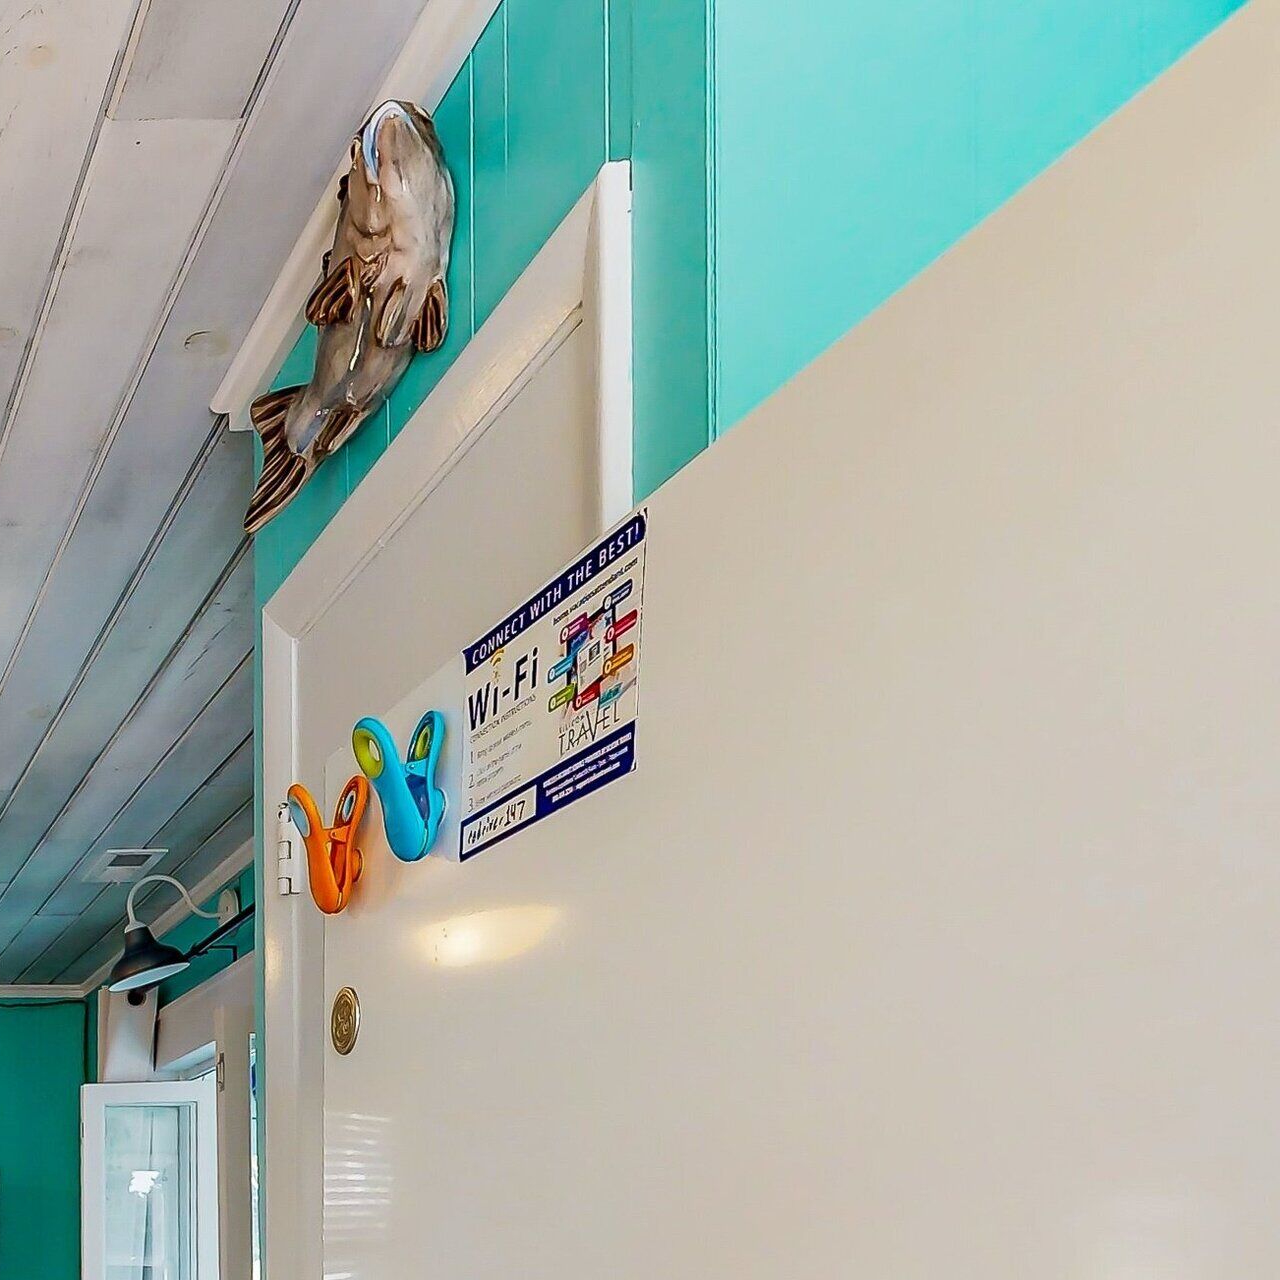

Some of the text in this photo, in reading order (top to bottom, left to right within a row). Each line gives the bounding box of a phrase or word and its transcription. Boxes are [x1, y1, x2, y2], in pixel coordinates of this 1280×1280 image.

[472, 611, 526, 666] CONNECT
[529, 585, 562, 621] WITH
[567, 560, 593, 591] THE
[598, 522, 640, 568] BEST!
[468, 646, 539, 732] Wi-Fi
[558, 701, 621, 757] TRAVEL
